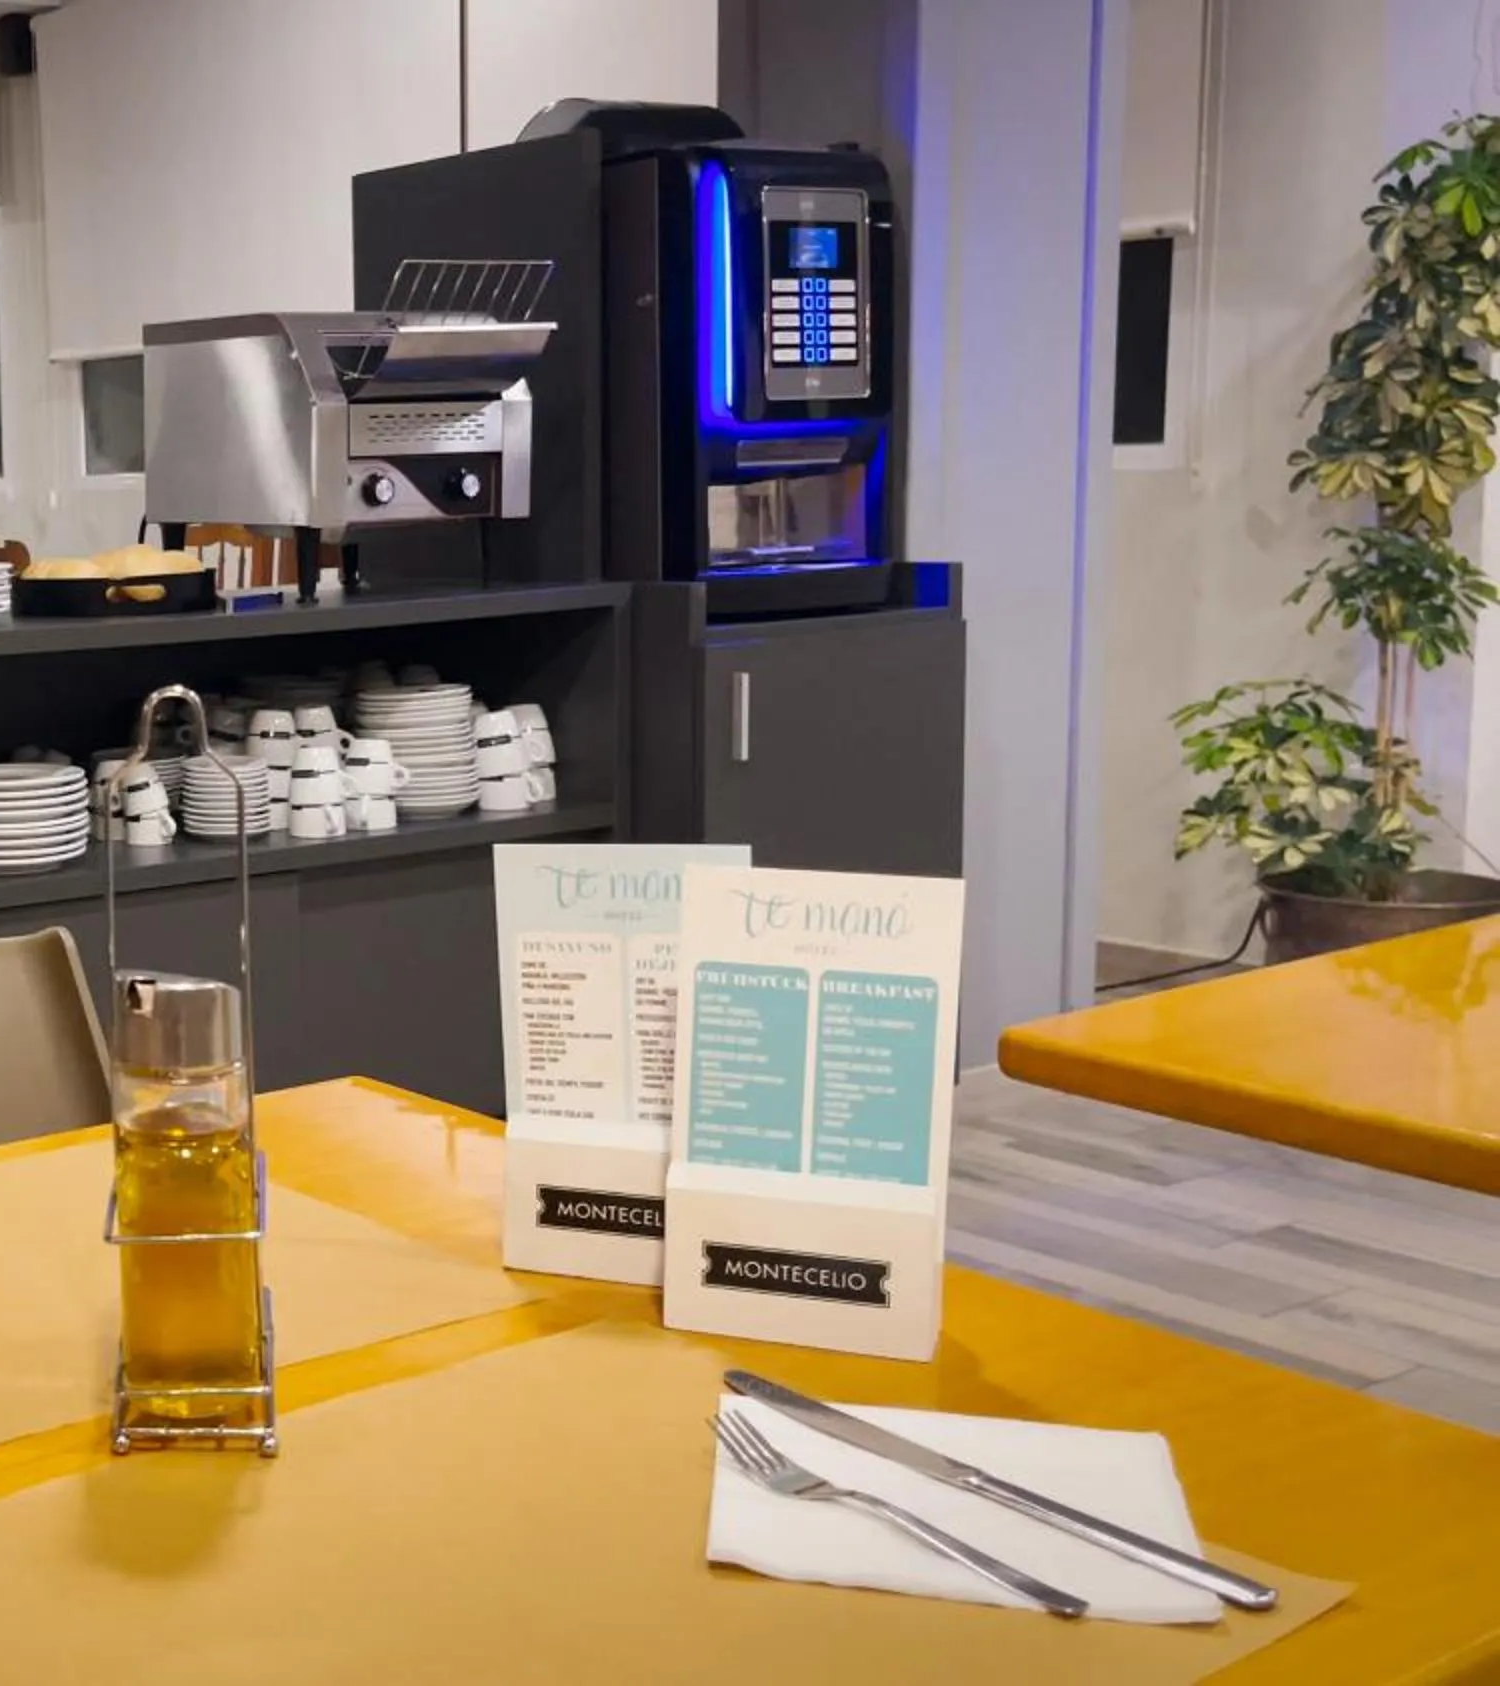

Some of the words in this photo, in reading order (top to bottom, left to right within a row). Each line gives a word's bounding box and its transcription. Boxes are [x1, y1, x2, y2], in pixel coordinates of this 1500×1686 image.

[609, 868, 682, 902] man
[822, 979, 936, 1003] BREAKFAST
[556, 1201, 663, 1227] MONTECEL
[723, 1259, 867, 1292] MONTECELIO
